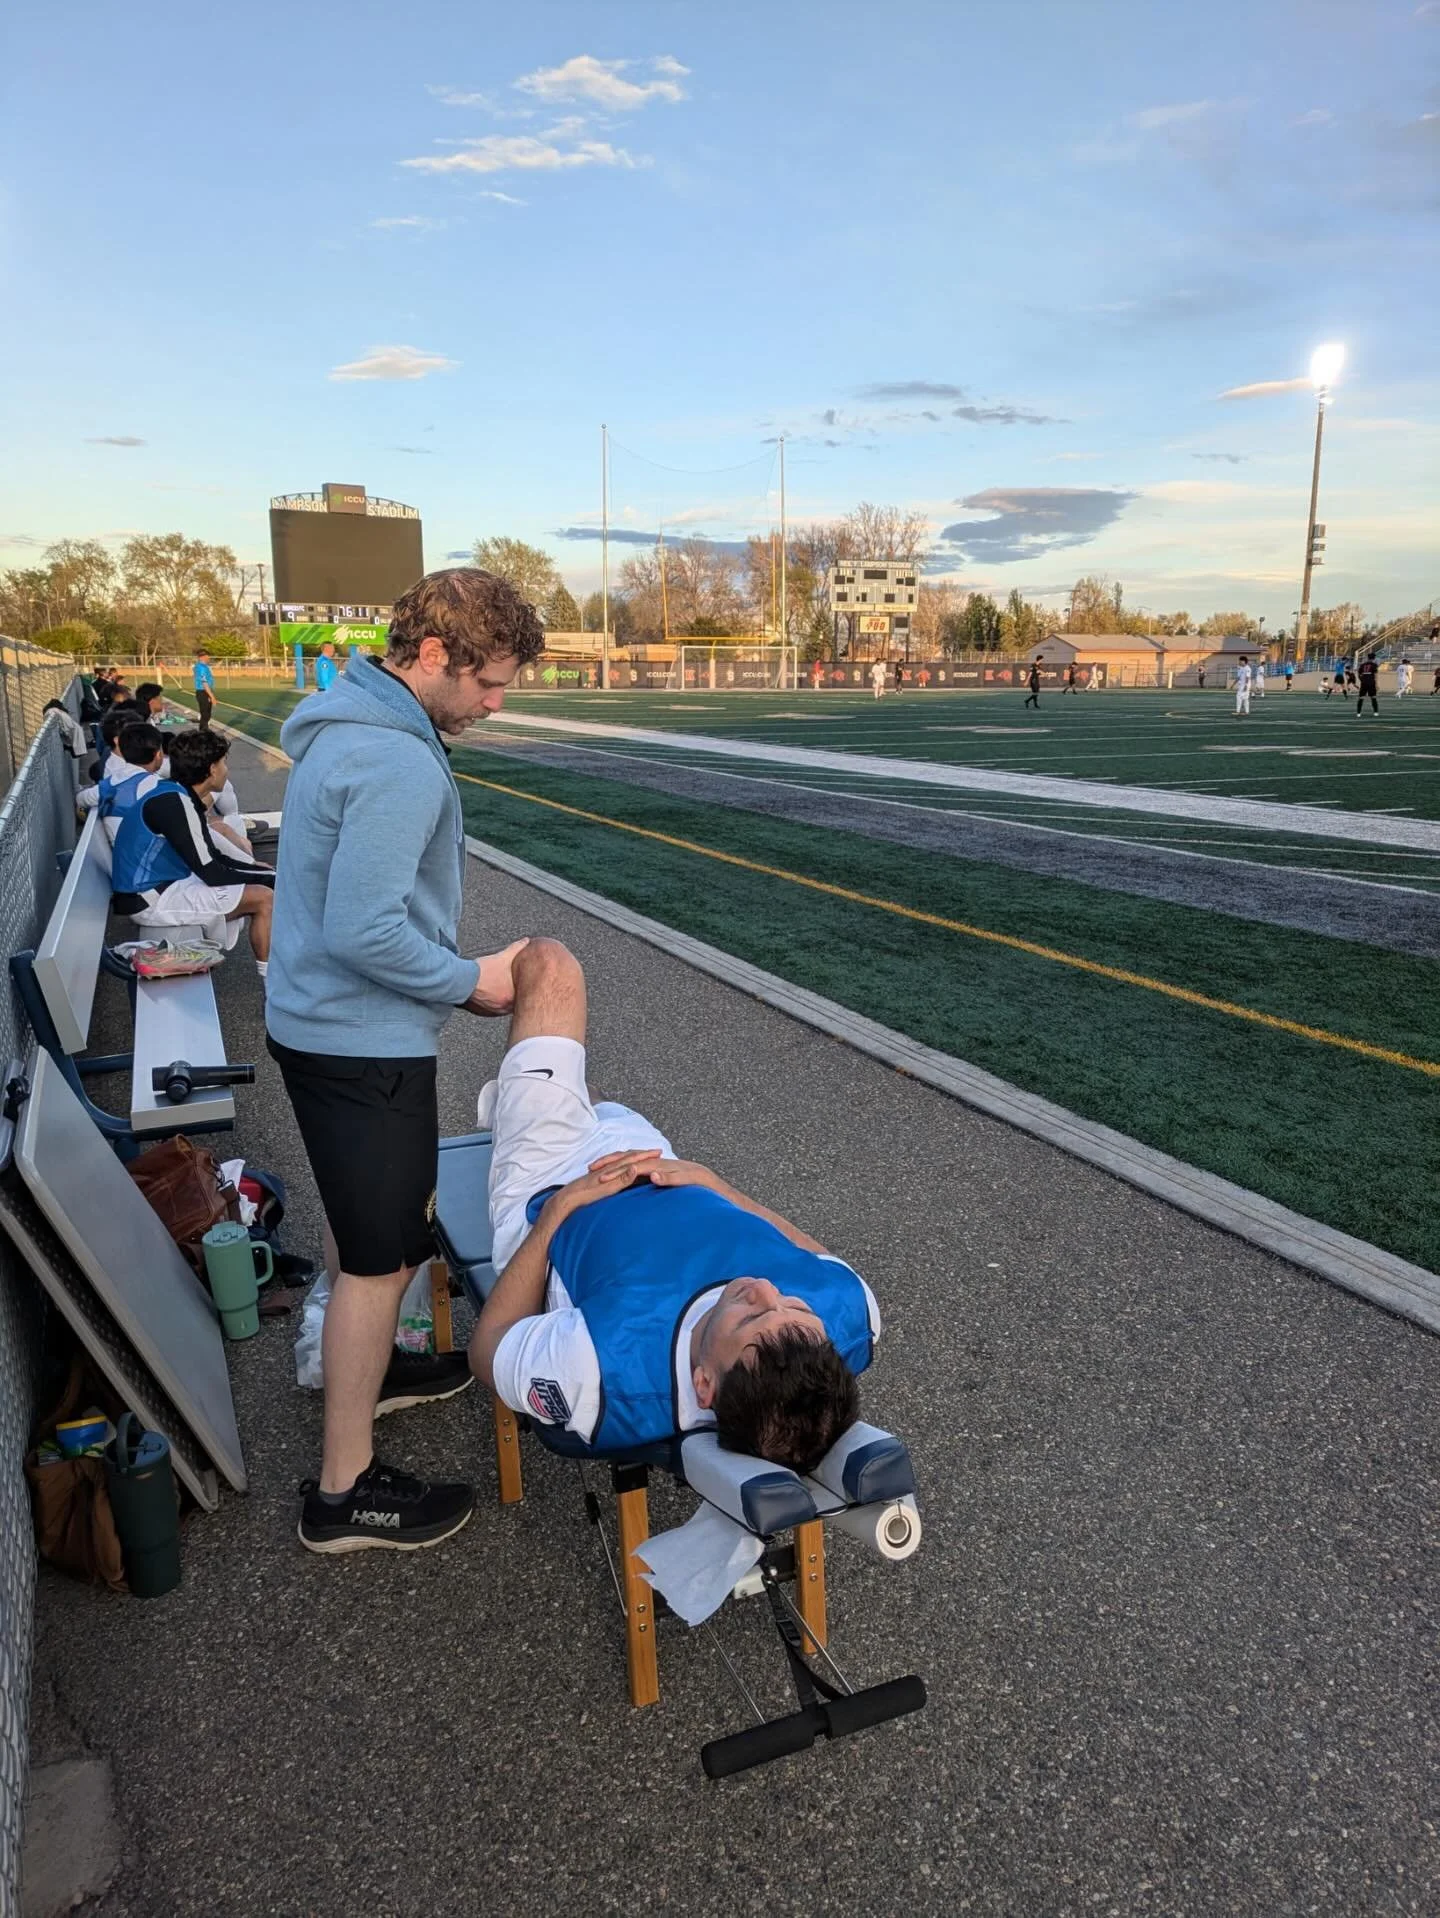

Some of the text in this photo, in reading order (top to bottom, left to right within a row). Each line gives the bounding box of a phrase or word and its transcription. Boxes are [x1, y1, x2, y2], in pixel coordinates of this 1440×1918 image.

[344, 495, 366, 503] ICCU
[272, 498, 418, 519] LAMPSON STADIUM
[287, 611, 295, 622] 9
[349, 630, 377, 639] ICCU
[556, 670, 580, 679] ICCU
[349, 1510, 401, 1529] HOKA
